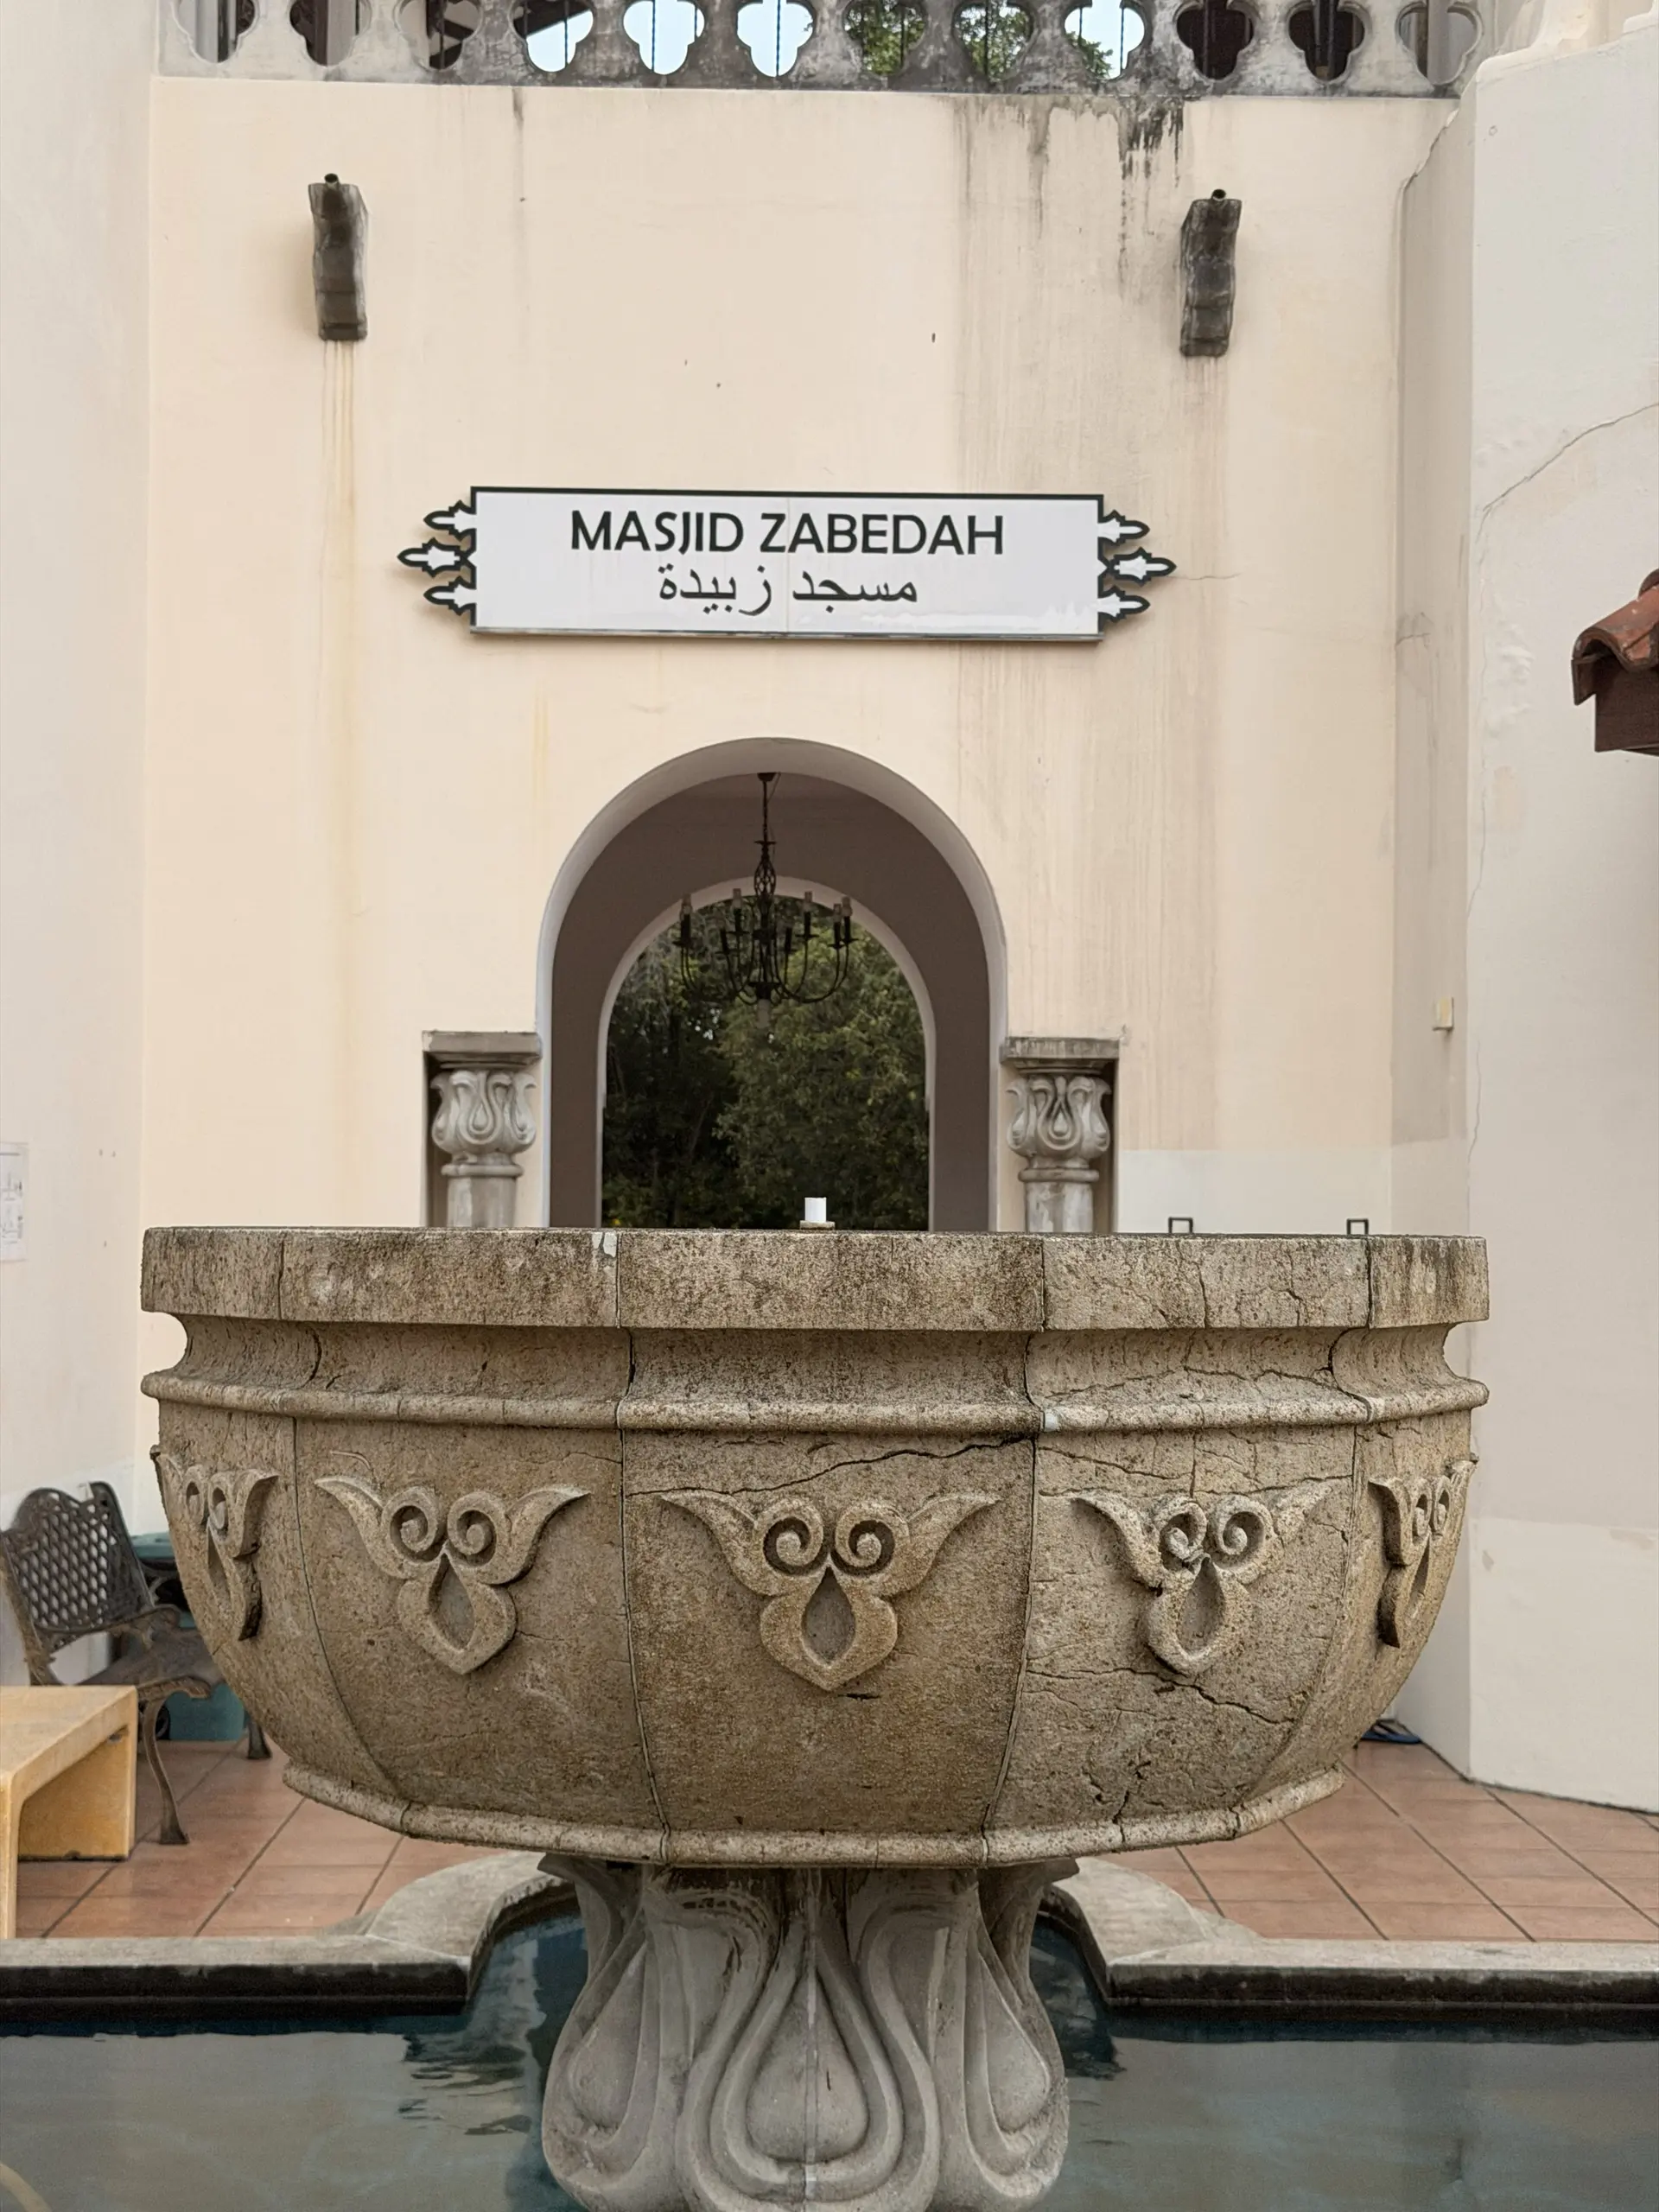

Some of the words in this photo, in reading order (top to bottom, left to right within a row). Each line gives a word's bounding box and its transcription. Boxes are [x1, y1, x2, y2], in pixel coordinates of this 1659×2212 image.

[571, 510, 744, 553] MASJID
[760, 512, 1004, 556] ZABEDAH
[658, 563, 772, 616] زبيدة
[792, 569, 918, 613] مسجد
